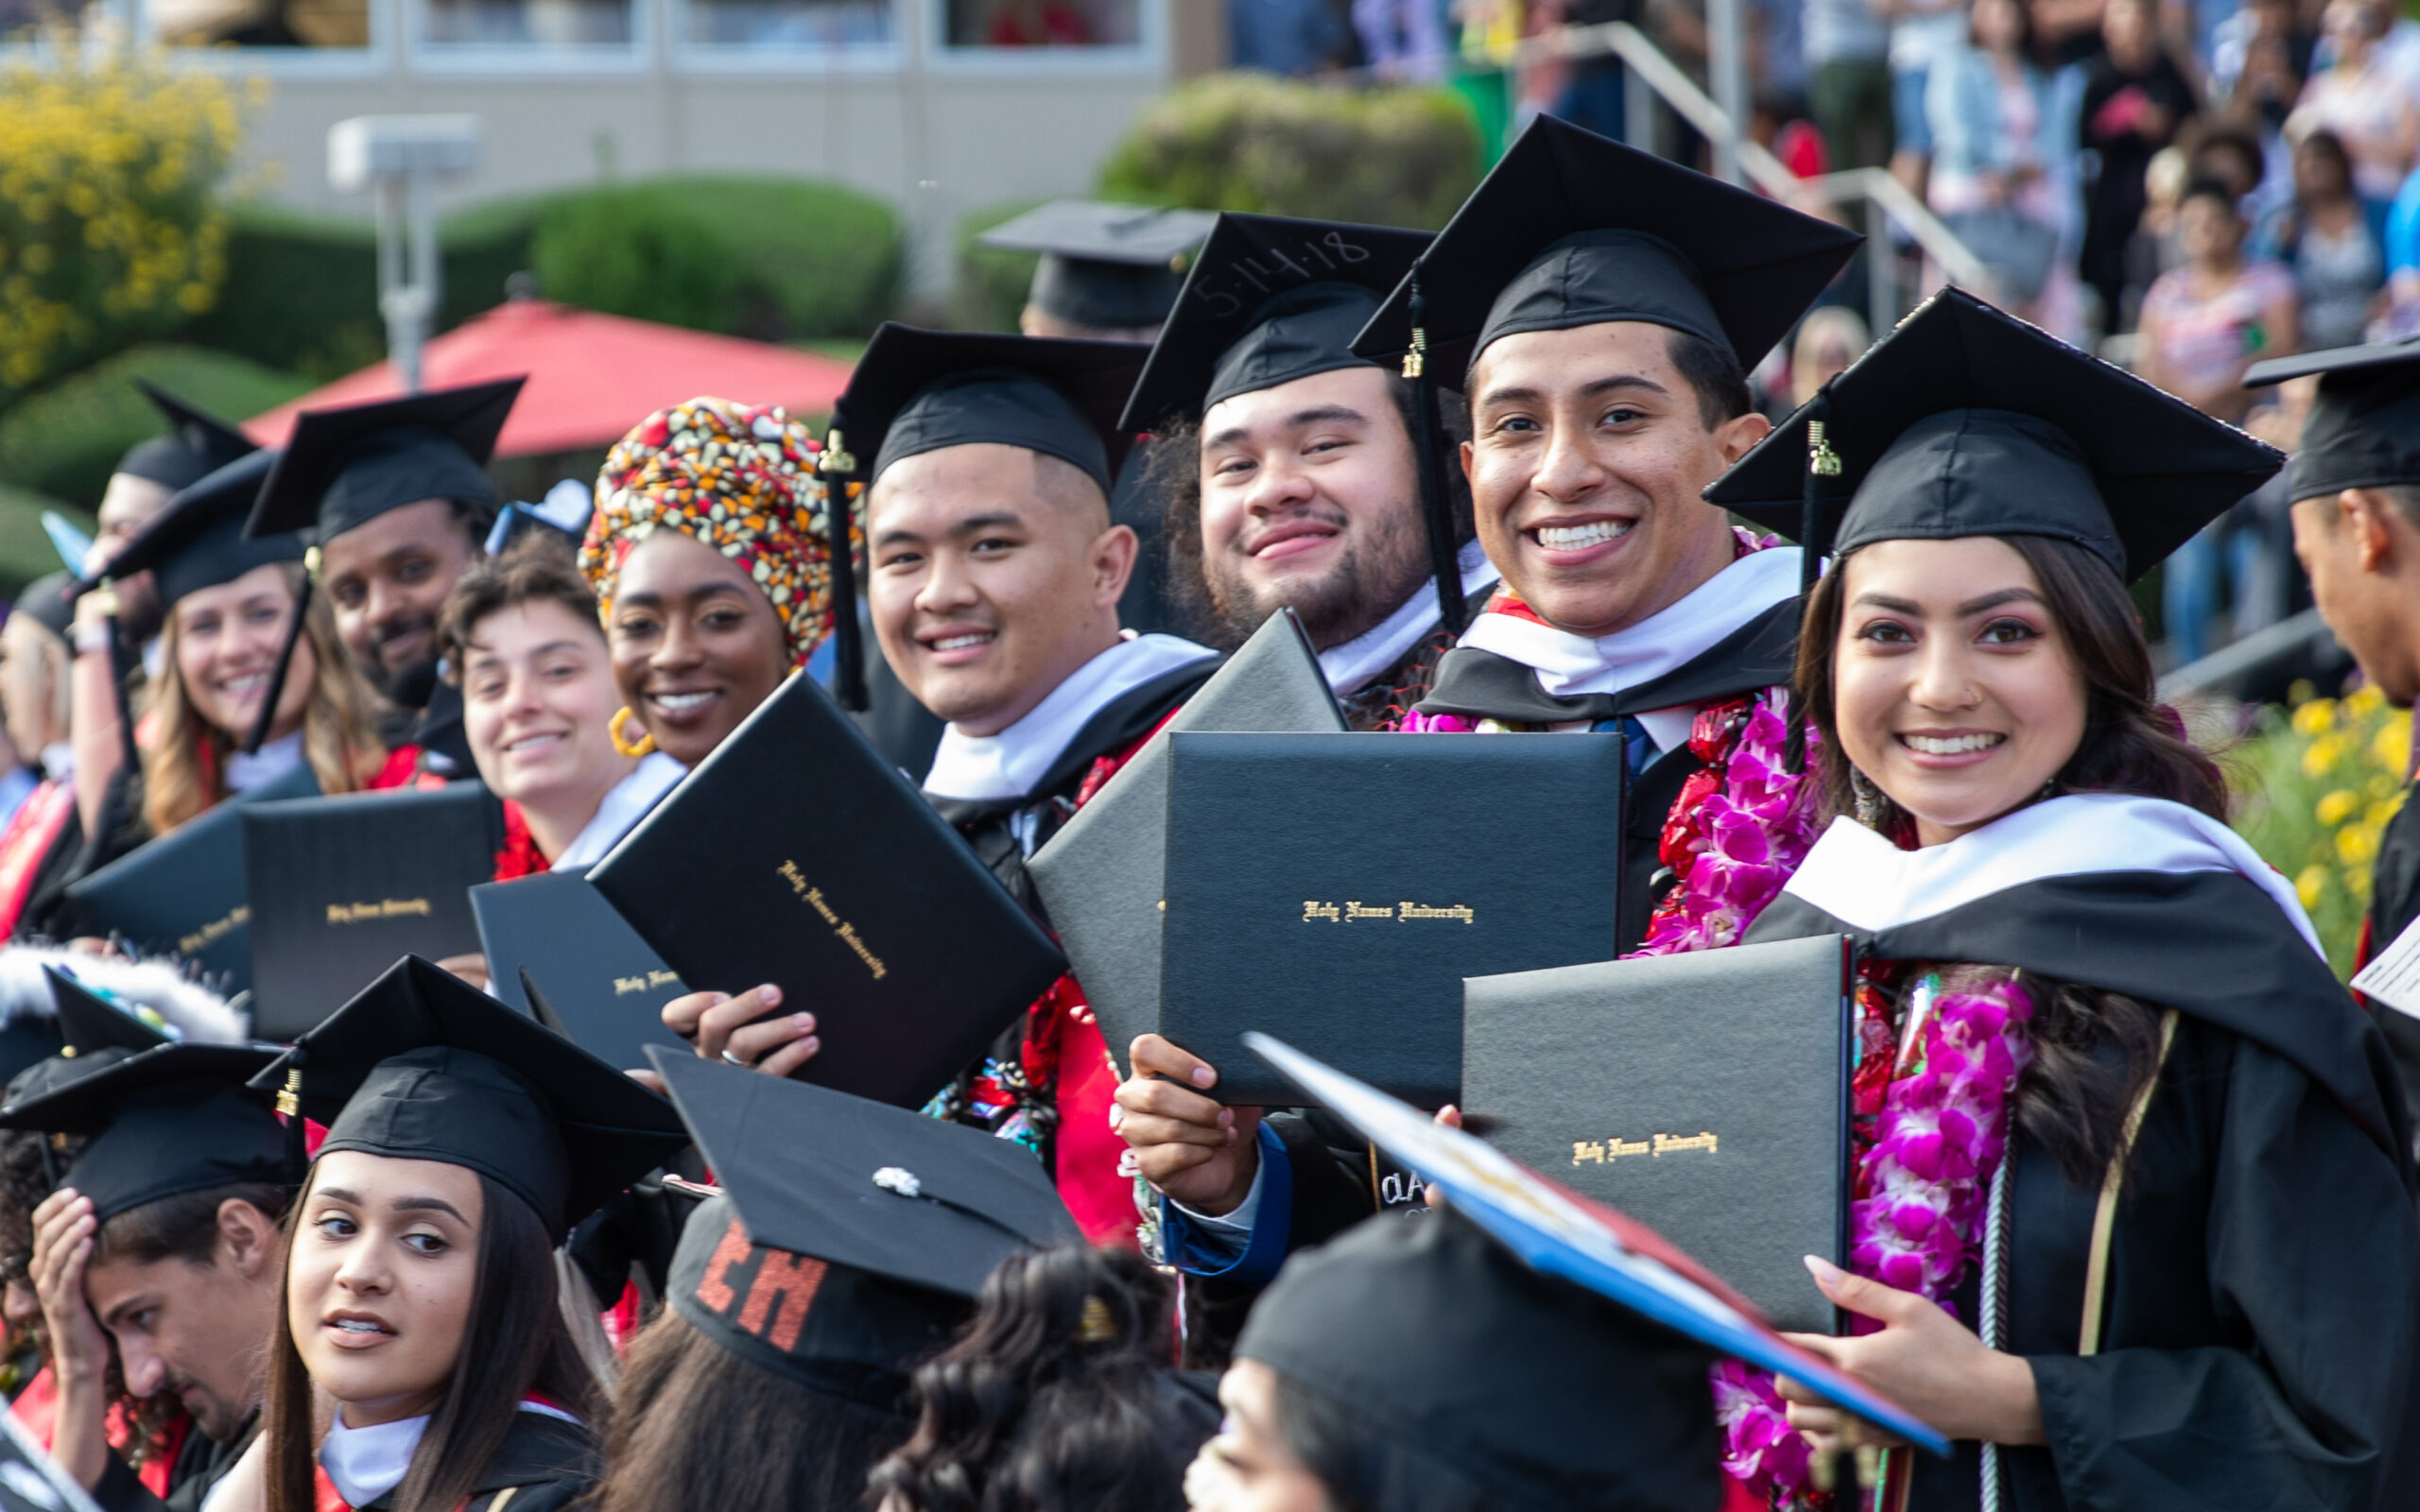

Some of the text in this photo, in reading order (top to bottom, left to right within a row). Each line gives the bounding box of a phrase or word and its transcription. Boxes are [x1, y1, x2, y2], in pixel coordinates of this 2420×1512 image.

[776, 859, 887, 979] Holy Names University
[1303, 901, 1474, 924] Holy Names University
[1572, 1131, 1718, 1166] Holy Names University
[1381, 1170, 1426, 1204] CLA
